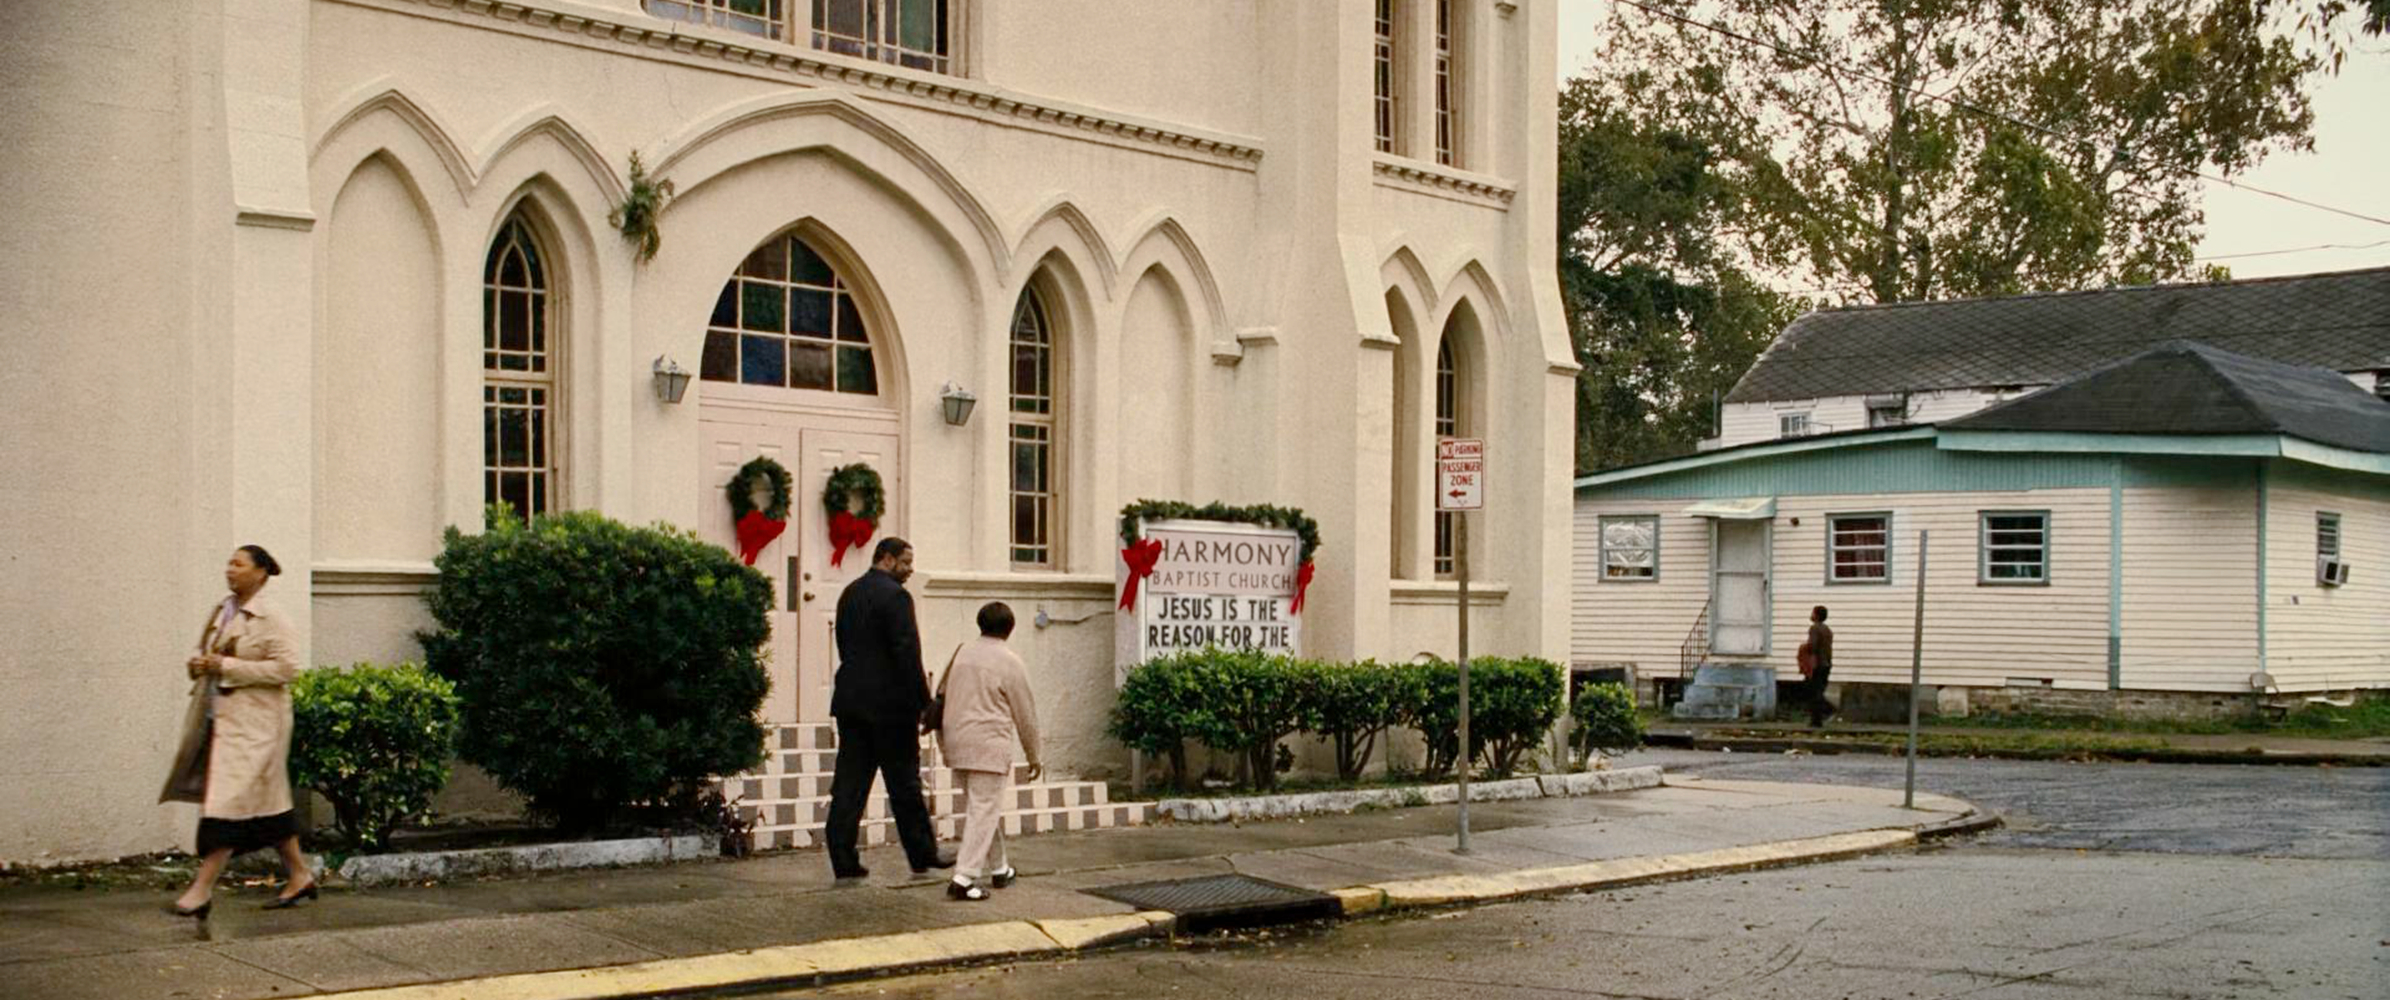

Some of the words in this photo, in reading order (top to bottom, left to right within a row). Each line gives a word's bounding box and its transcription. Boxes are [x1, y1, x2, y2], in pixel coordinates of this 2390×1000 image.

[1455, 445, 1480, 454] PARKING
[1442, 462, 1480, 472] PASSENGER
[1450, 475, 1474, 486] ZONE
[1153, 570, 1220, 587] BAPTIST
[1229, 573, 1291, 589] CHURCH
[1158, 597, 1213, 621] JESUS
[1221, 598, 1238, 621] IS
[1248, 599, 1278, 621] THE
[1149, 625, 1215, 648] REASON
[1221, 625, 1252, 648] FOR
[1260, 626, 1289, 648] THE
